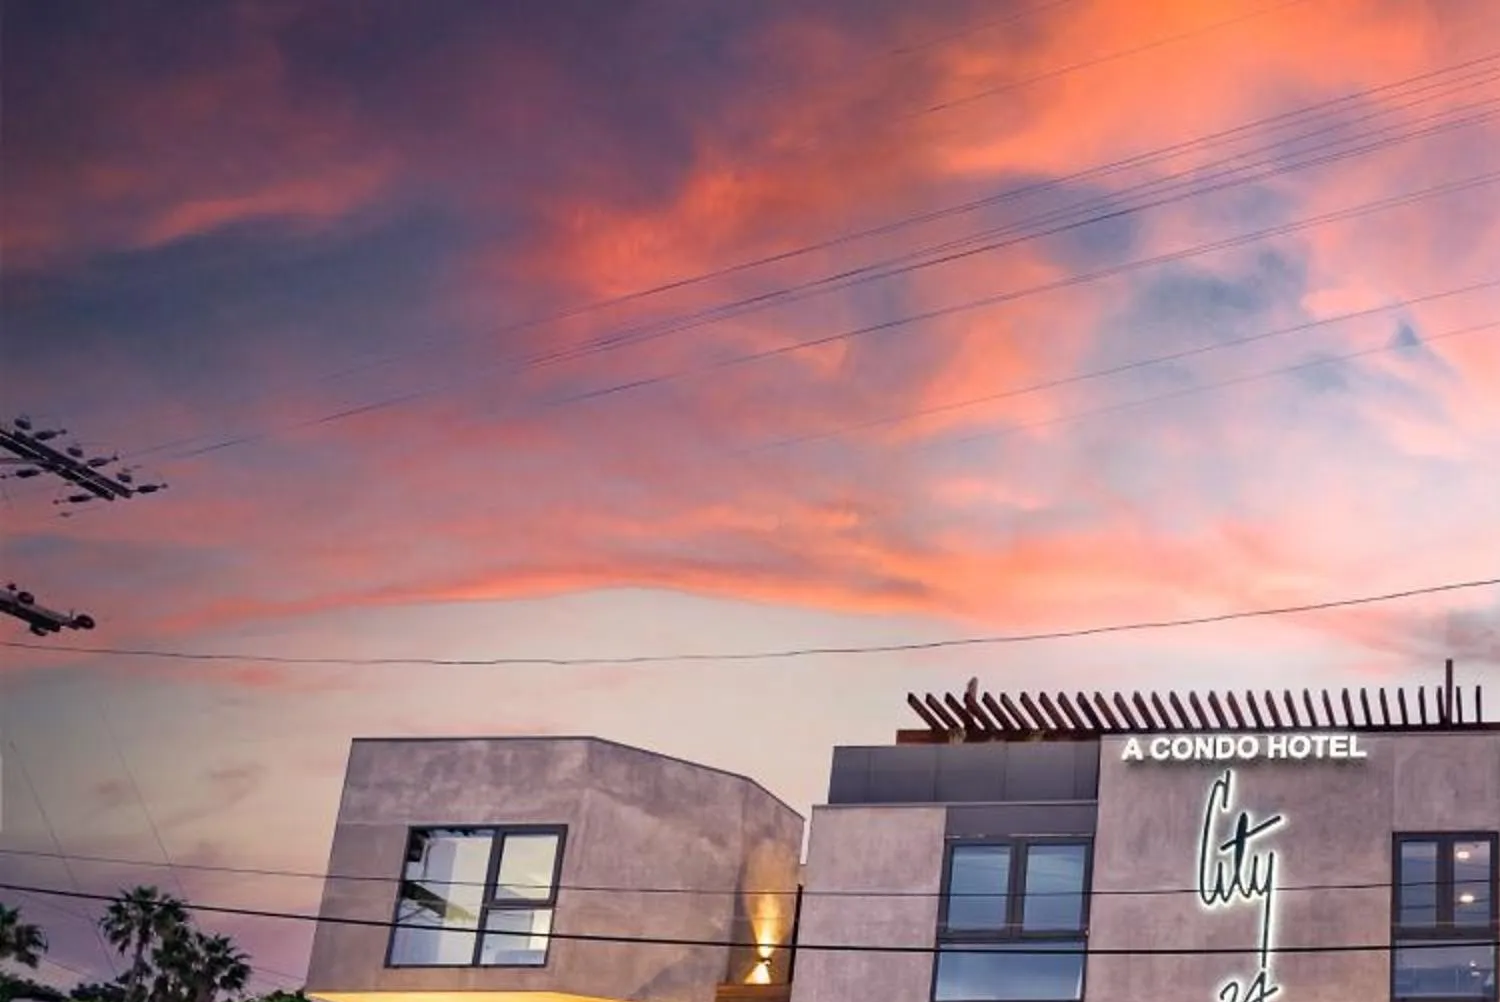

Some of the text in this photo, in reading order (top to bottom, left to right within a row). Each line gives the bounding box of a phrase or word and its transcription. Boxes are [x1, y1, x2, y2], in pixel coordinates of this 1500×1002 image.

[1121, 734, 1367, 761] A CONDO HOTEL
[1199, 769, 1282, 968] City
